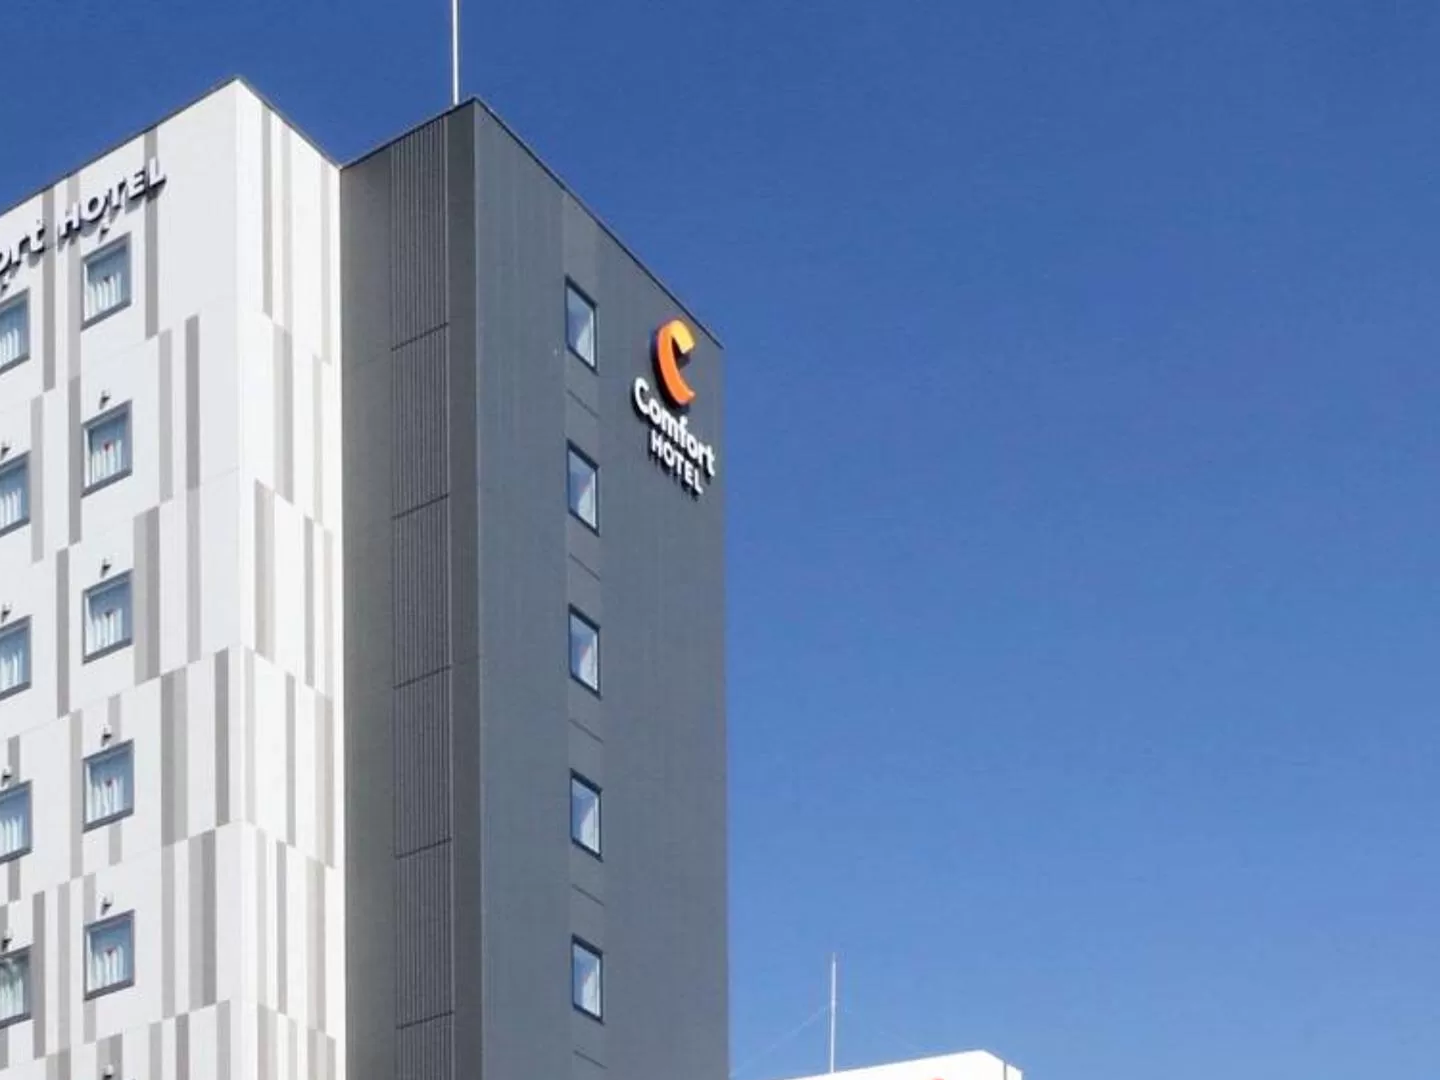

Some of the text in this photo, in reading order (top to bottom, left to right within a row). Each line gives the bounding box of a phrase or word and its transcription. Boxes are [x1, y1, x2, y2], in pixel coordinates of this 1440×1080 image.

[60, 157, 167, 240] HOTEL
[634, 376, 715, 477] Comfort
[650, 430, 703, 495] HOTEL
